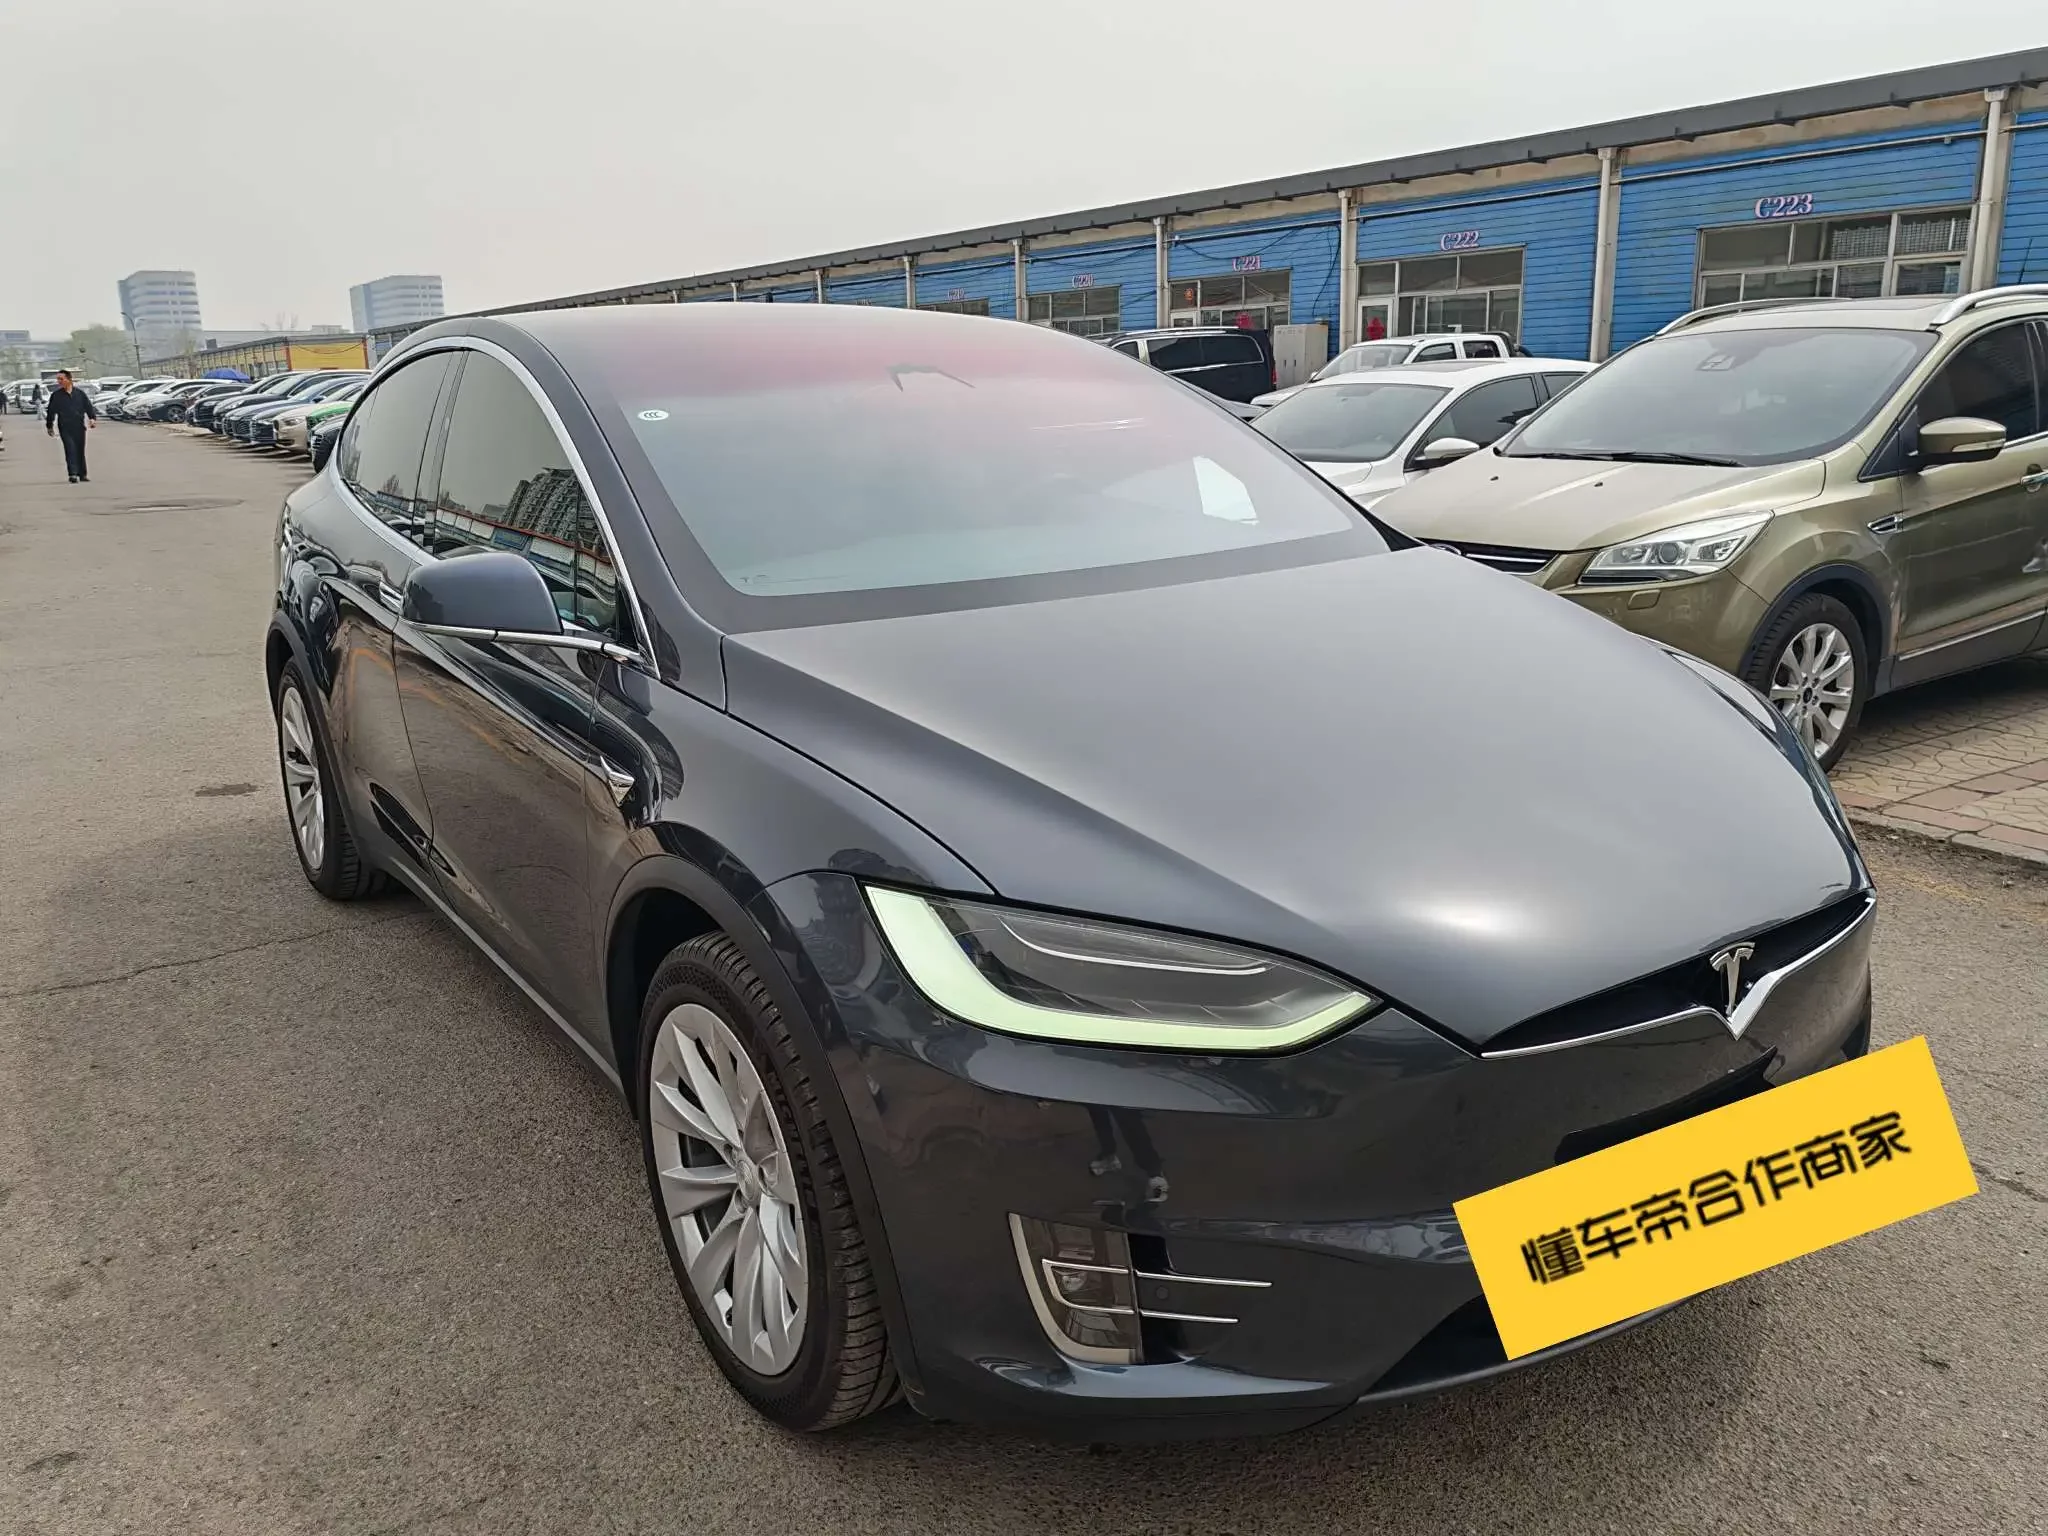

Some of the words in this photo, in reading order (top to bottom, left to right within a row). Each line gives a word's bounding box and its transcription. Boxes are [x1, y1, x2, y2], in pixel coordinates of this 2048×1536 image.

[1754, 192, 1813, 219] C223
[1440, 230, 1480, 251] C222
[1231, 255, 1262, 272] C221
